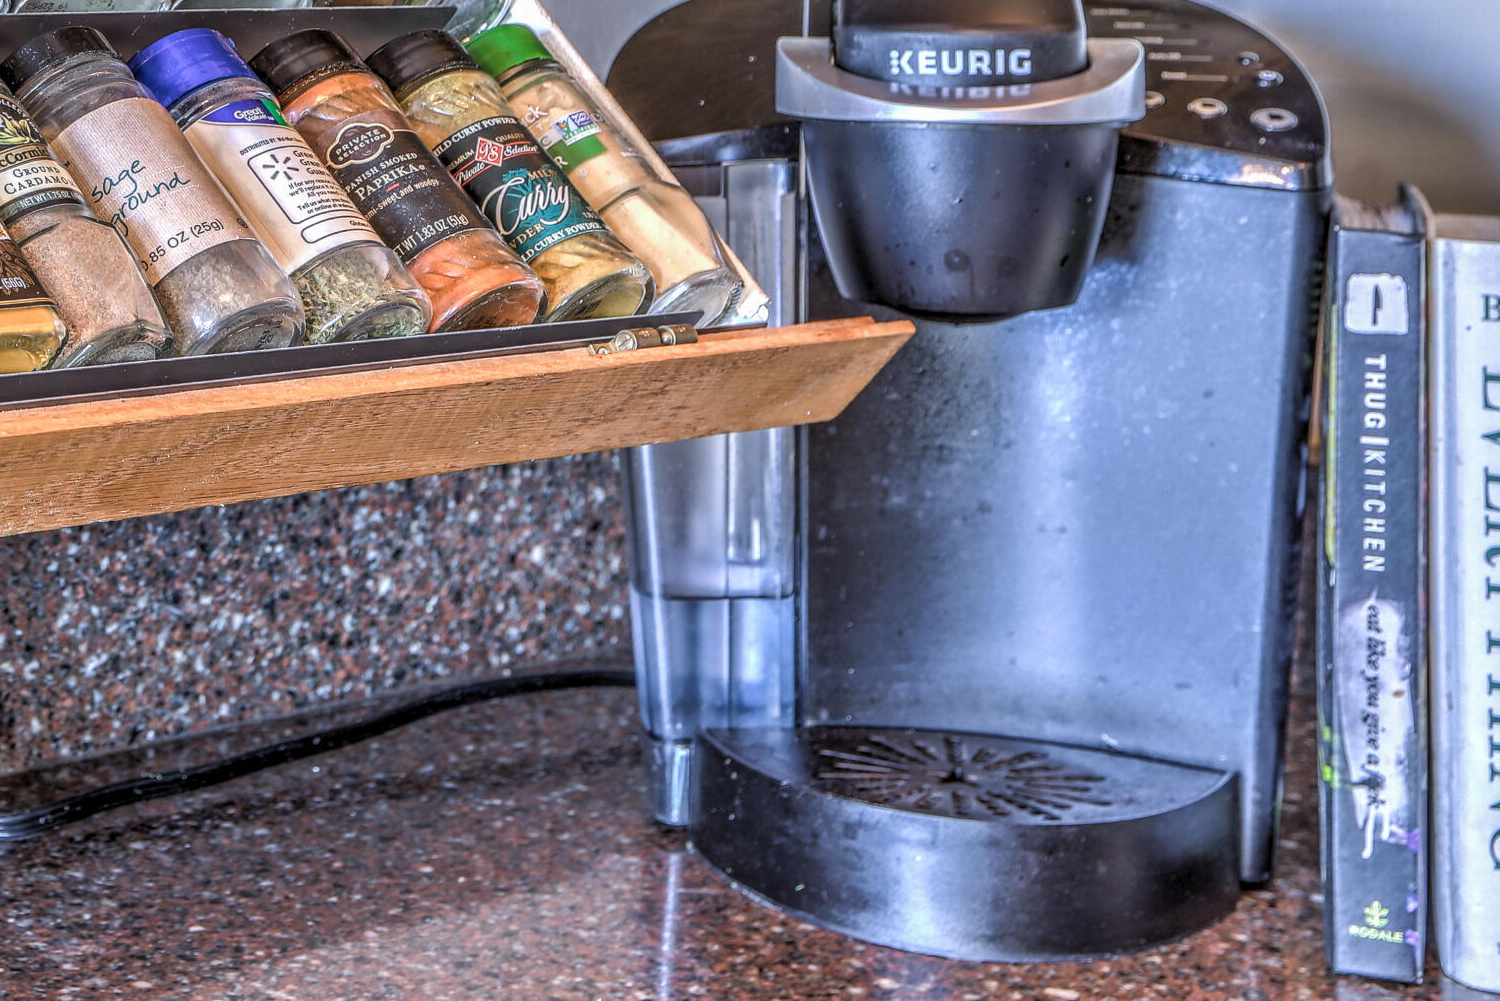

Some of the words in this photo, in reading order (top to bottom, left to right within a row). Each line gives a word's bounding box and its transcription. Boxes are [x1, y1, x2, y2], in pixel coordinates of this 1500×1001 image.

[890, 48, 1032, 76] KEURIG
[234, 107, 265, 119] Great
[335, 128, 381, 155] PRIVATE
[452, 123, 482, 143] CURRY
[482, 115, 517, 128] POWDER
[338, 133, 387, 161] SELECTION
[12, 165, 60, 178] GROUND
[345, 166, 379, 193] PANISH
[379, 152, 418, 169] SMOKED
[454, 162, 486, 186] Private
[503, 145, 538, 157] Selection
[90, 159, 147, 204] sage
[355, 163, 421, 201] PAPRIKA
[20, 196, 34, 209] NET
[34, 194, 47, 205] WT
[110, 172, 191, 239] ground
[365, 192, 401, 220] emi-sweet
[400, 184, 414, 198] and
[481, 177, 572, 236] Curry
[167, 231, 190, 249] OZ
[190, 218, 225, 238] (25g)
[403, 236, 418, 251] WT
[415, 224, 436, 241] 1.83
[434, 218, 448, 232] OZ
[447, 214, 470, 228] (51g)
[509, 222, 546, 250] WDER
[534, 231, 565, 251] CURRY
[565, 221, 601, 234] POWDER
[2, 277, 27, 291] (56G)
[1363, 353, 1387, 428] THUG
[1362, 449, 1387, 573] KITCHEN
[1367, 605, 1384, 632] eat
[1366, 637, 1386, 669] like
[1360, 670, 1381, 708] you
[1361, 710, 1385, 749] give
[1367, 754, 1381, 766] a
[1361, 765, 1387, 809] fck
[1348, 924, 1404, 943] RODALE
